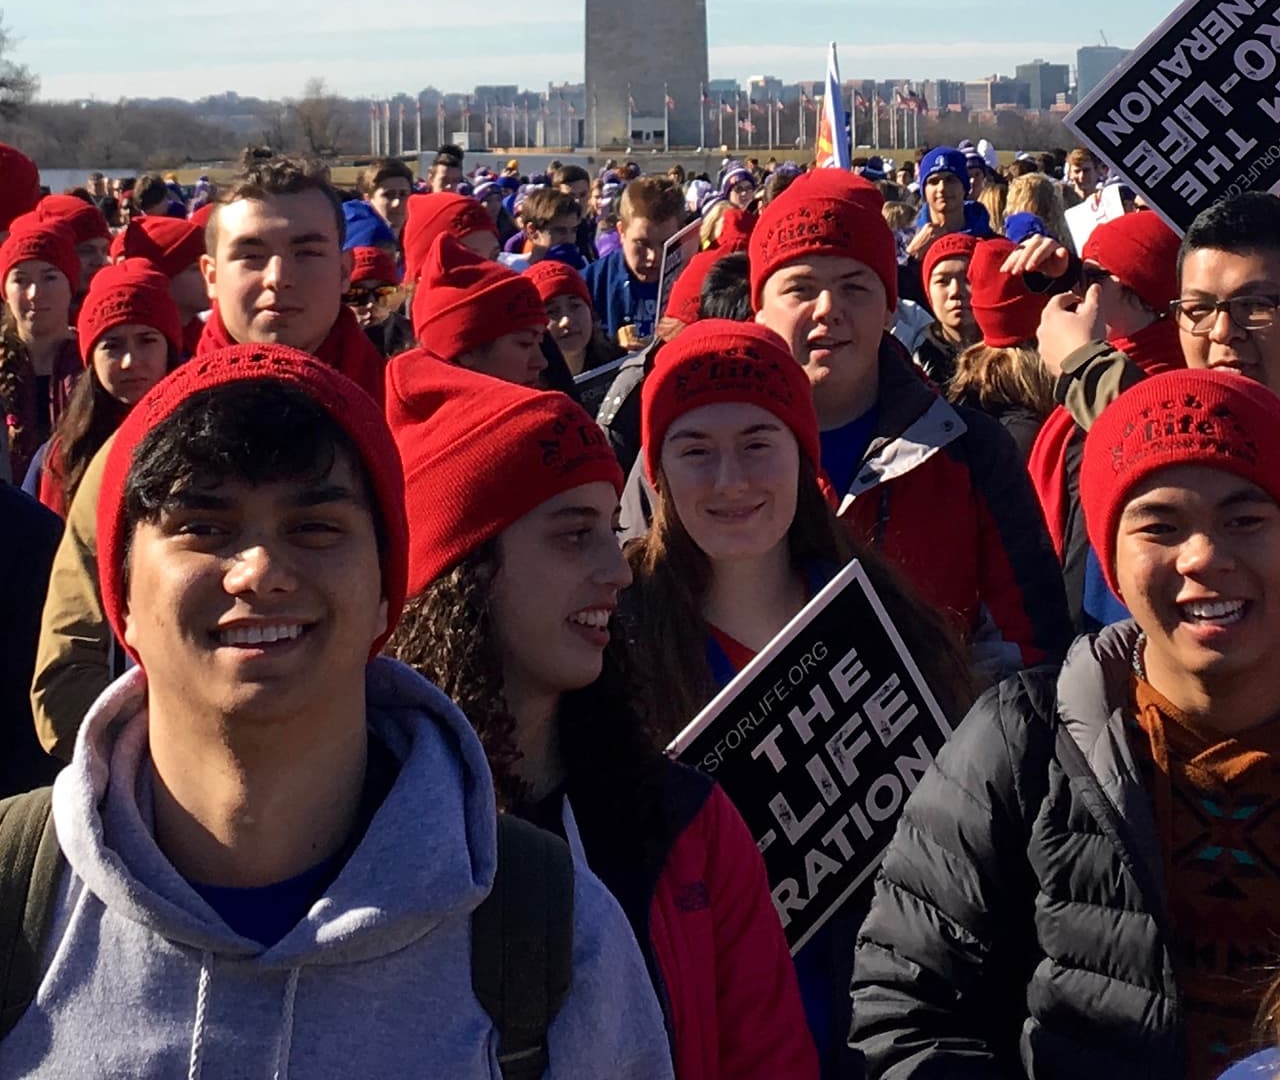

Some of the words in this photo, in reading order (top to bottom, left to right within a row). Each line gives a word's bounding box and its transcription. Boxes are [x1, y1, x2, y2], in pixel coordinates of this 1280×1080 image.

[1172, 128, 1258, 206] THE
[1144, 414, 1217, 442] Life
[751, 647, 871, 773] THE
